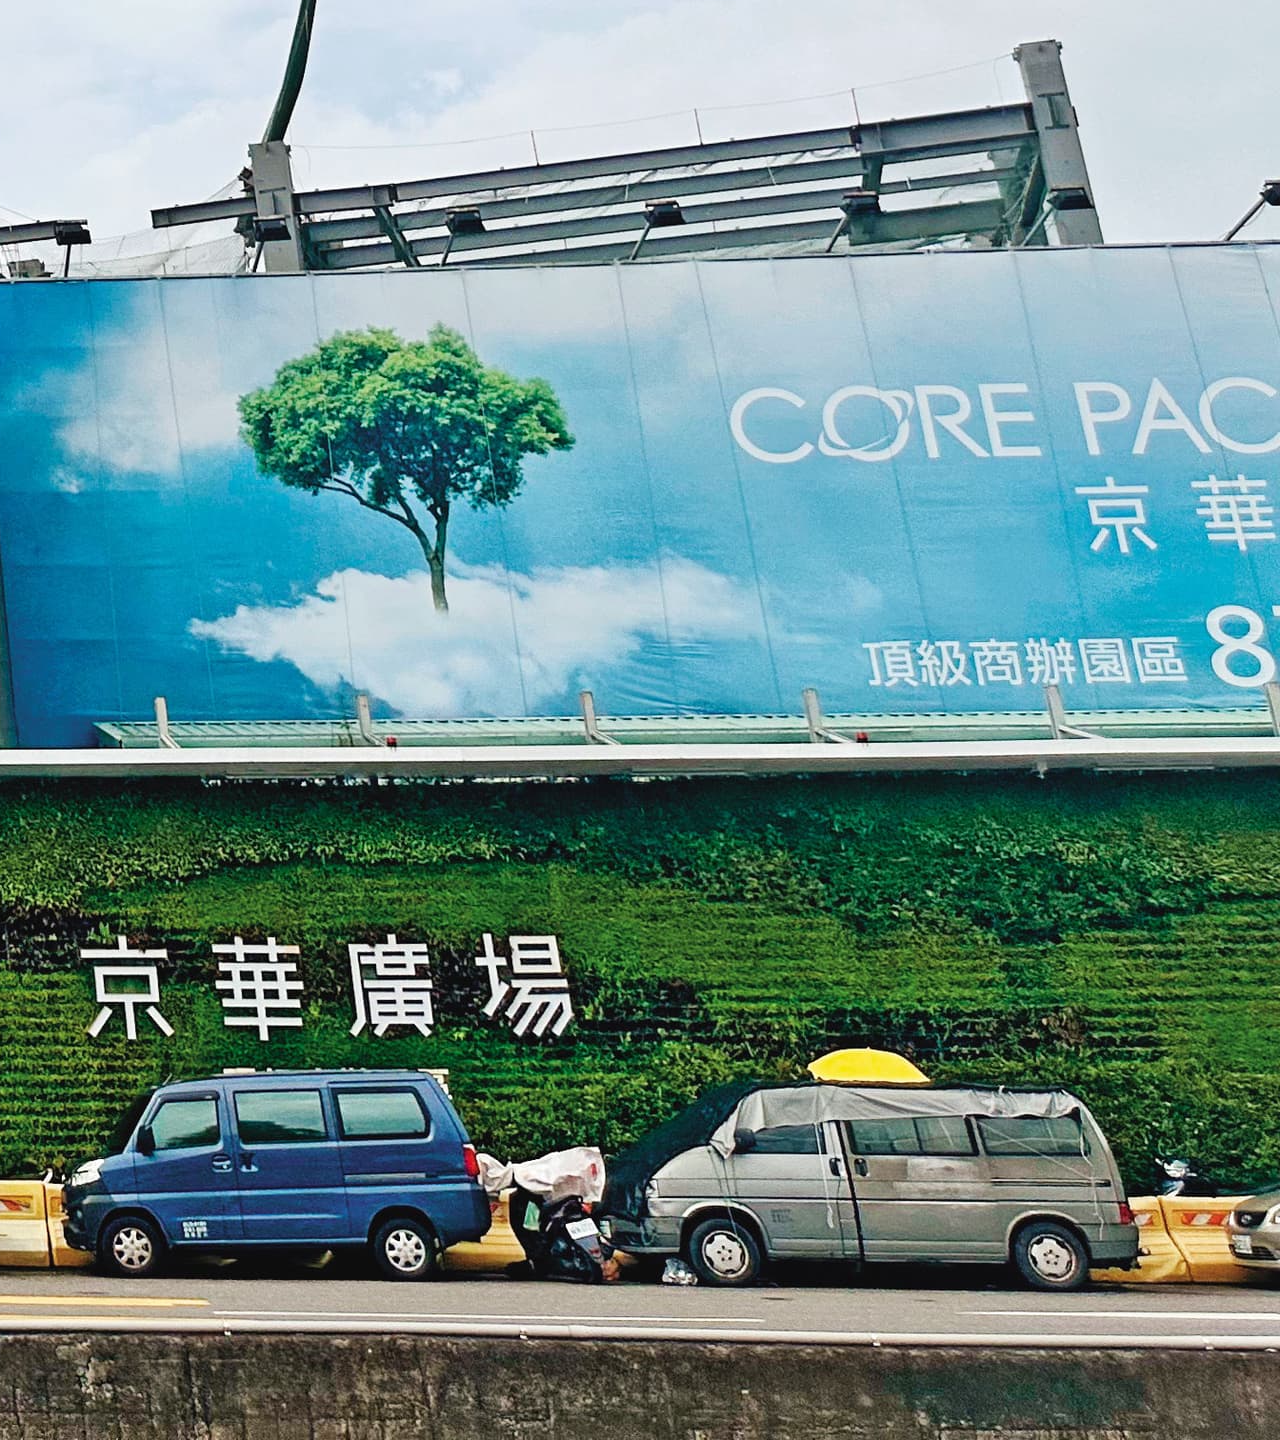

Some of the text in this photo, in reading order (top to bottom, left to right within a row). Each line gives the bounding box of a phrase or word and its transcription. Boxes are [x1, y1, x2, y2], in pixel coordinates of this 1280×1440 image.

[730, 383, 1043, 463] CORE
[1074, 473, 1277, 554] 京華
[862, 605, 1280, 688] 頂級商辦園區 8
[80, 933, 575, 1042] 京華廣場
